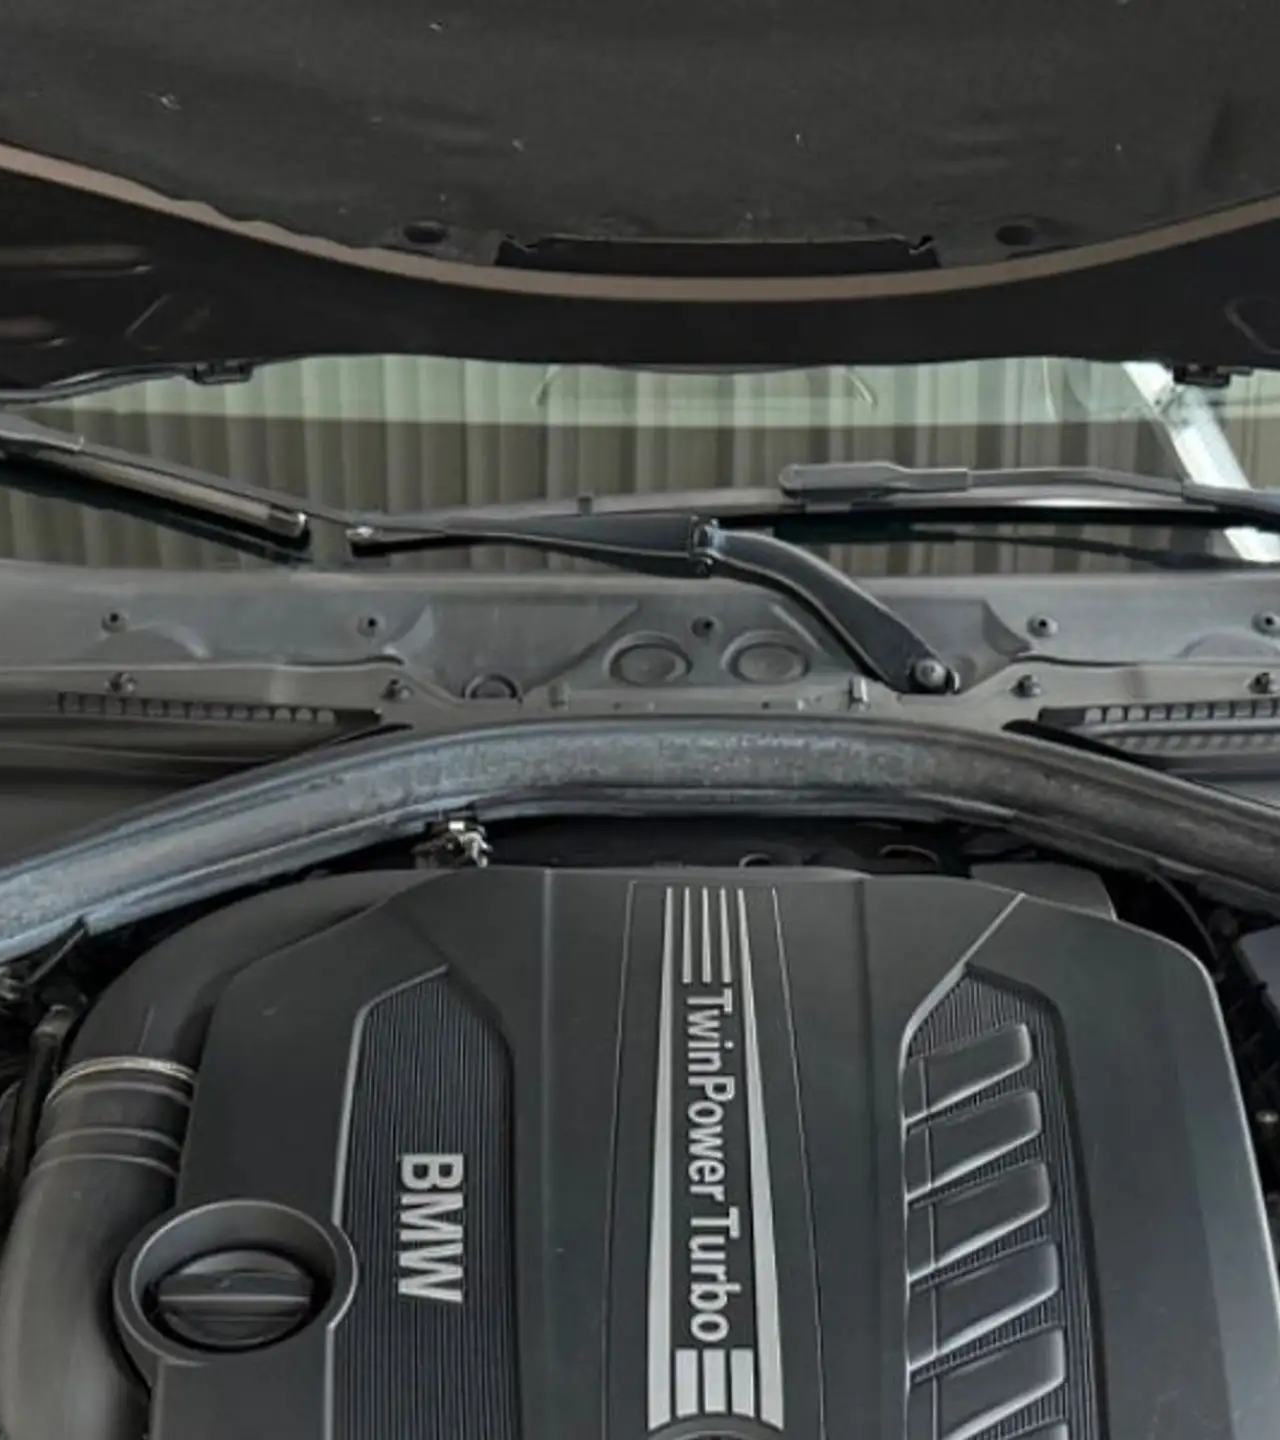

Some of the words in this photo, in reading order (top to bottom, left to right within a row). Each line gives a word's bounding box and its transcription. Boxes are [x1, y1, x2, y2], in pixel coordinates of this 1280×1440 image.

[687, 987, 735, 1201] TwinPower
[398, 1154, 463, 1303] BMW
[689, 1206, 741, 1342] Turbo
